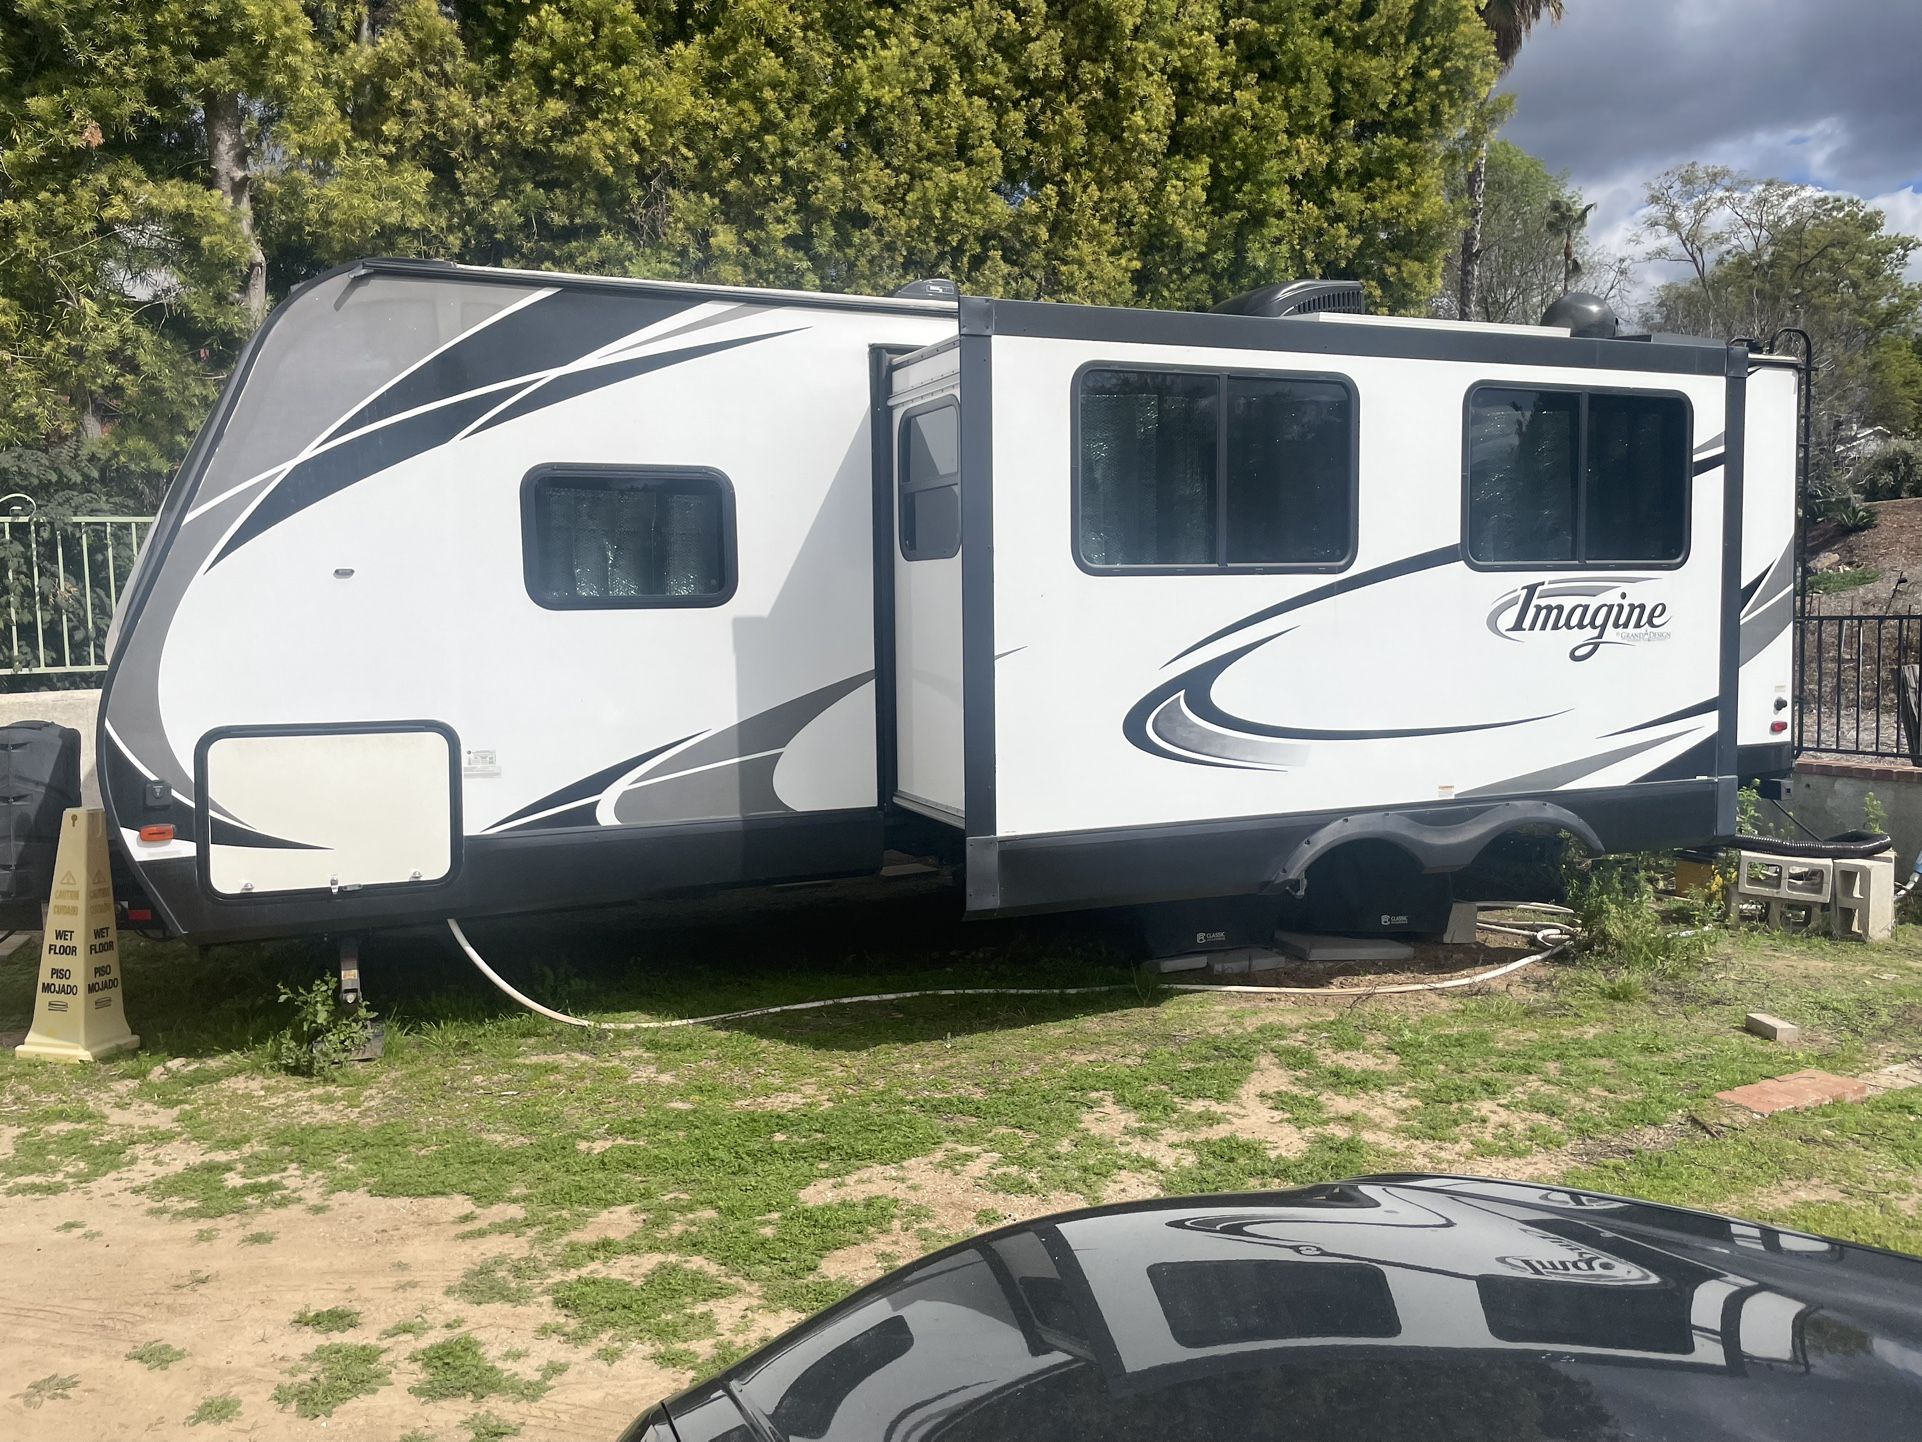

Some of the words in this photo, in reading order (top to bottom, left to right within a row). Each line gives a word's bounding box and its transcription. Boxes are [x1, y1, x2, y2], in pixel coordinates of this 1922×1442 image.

[1505, 580, 1672, 662] Imagine
[55, 929, 74, 941] WET
[94, 927, 109, 939] WET
[48, 944, 77, 956] FLOOR
[89, 941, 114, 954] FLOOR
[51, 968, 71, 980] PISO
[94, 964, 111, 978] PISO
[41, 982, 78, 995] MOJADO
[87, 978, 119, 994] MOJADO
